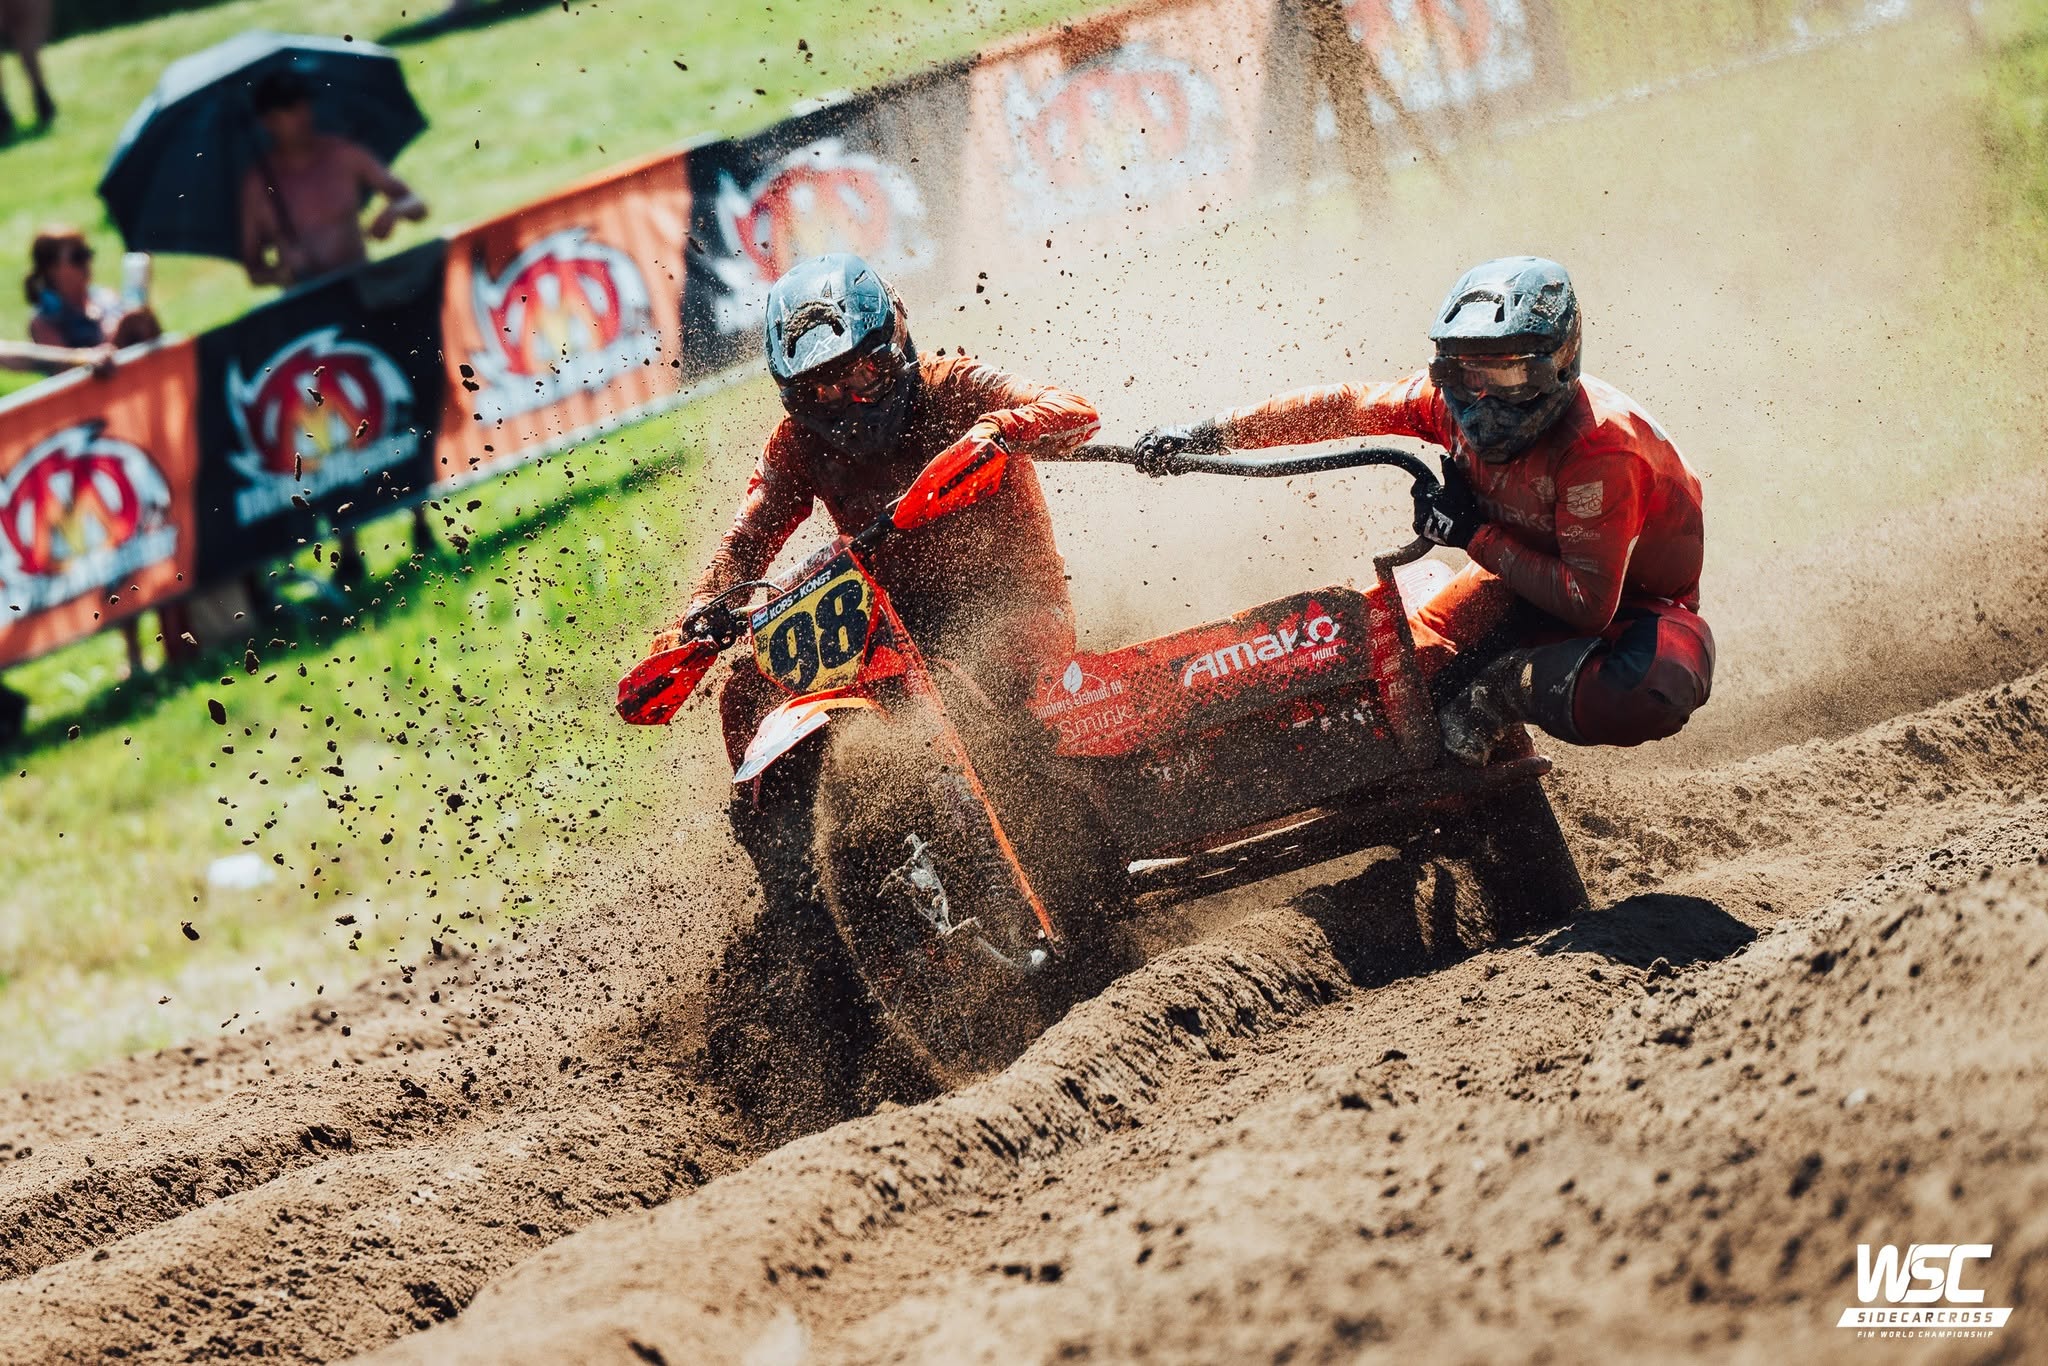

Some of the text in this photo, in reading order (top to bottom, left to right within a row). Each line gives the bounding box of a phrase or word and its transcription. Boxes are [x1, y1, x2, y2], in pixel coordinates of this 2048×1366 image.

[769, 595, 794, 620] KOPS
[769, 579, 868, 694] 98
[1059, 704, 1132, 743] Smink
